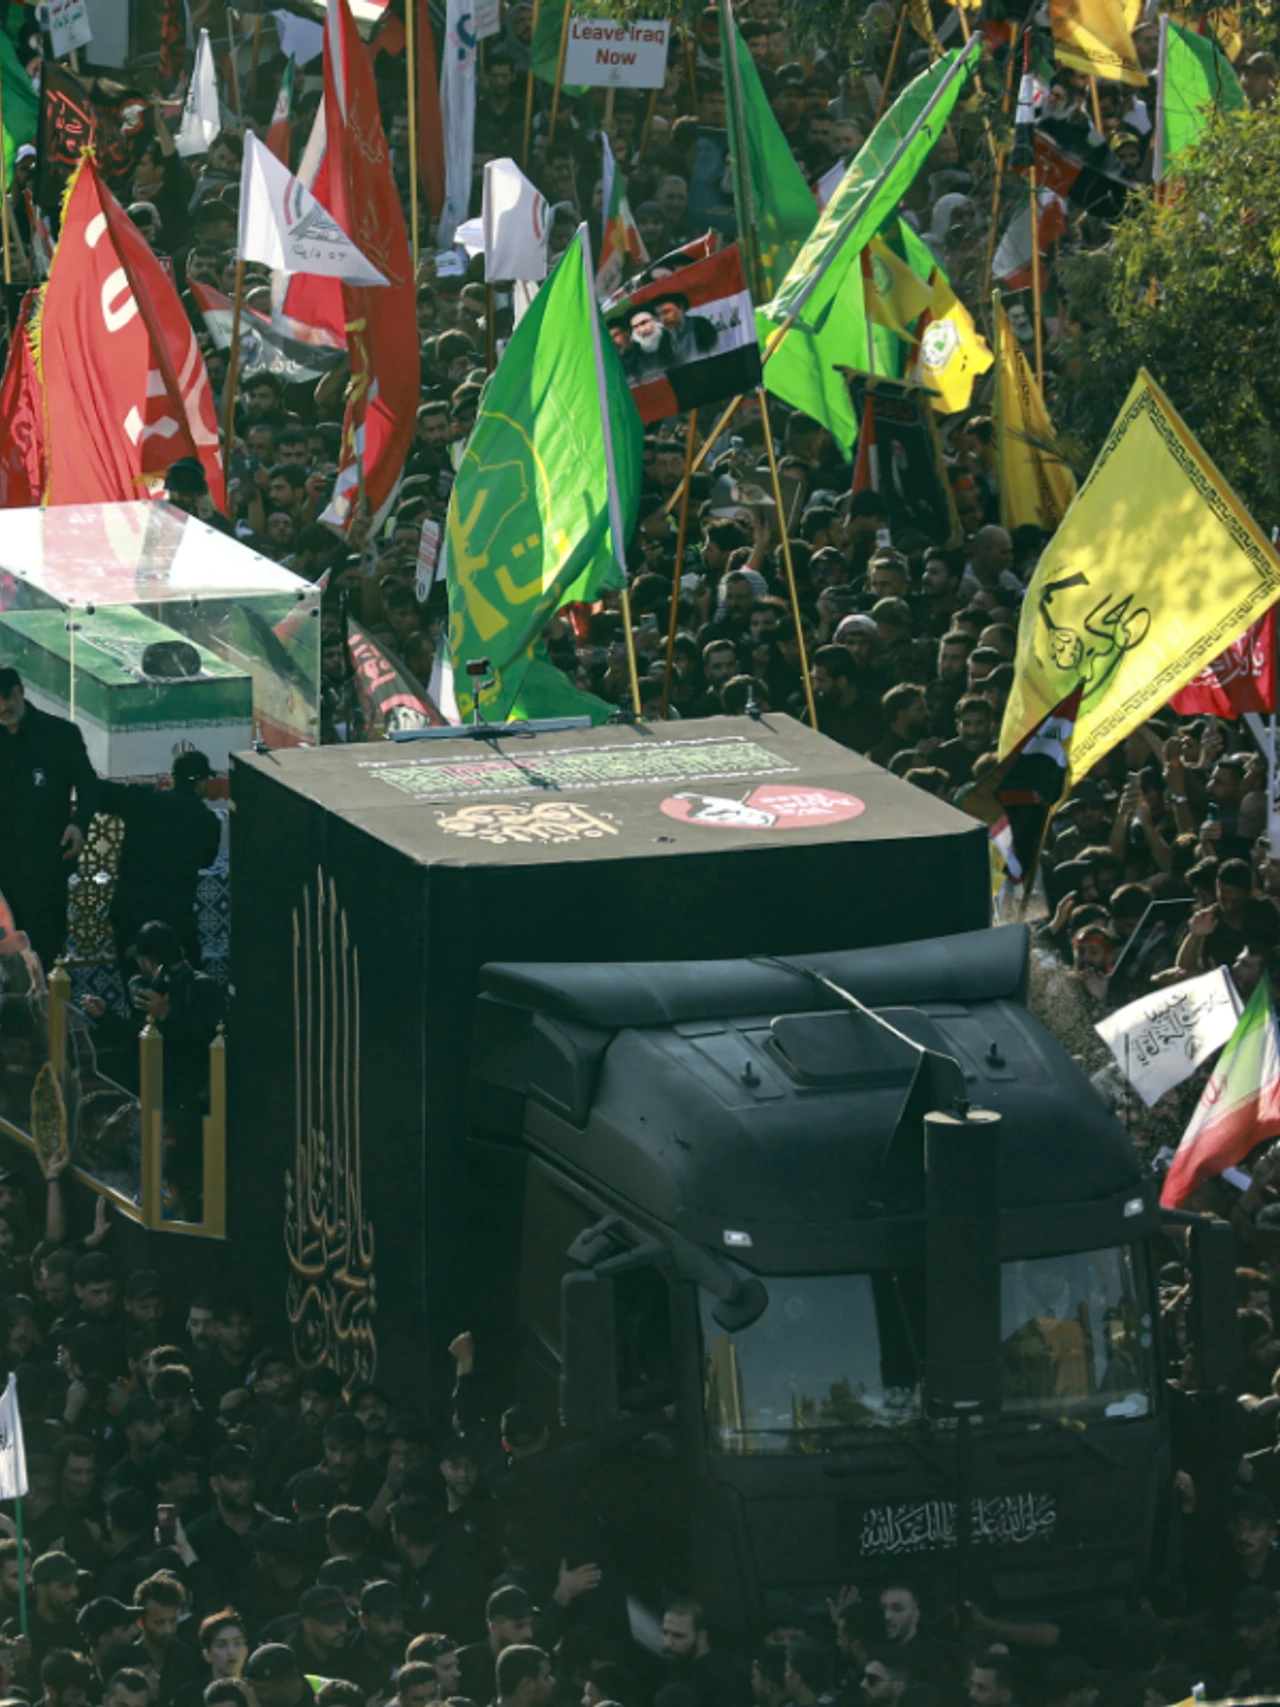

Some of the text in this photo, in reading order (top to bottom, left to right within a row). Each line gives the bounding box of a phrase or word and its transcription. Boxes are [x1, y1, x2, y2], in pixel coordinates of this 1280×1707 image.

[572, 23, 665, 46] Leave Iraq
[595, 49, 637, 65] Now
